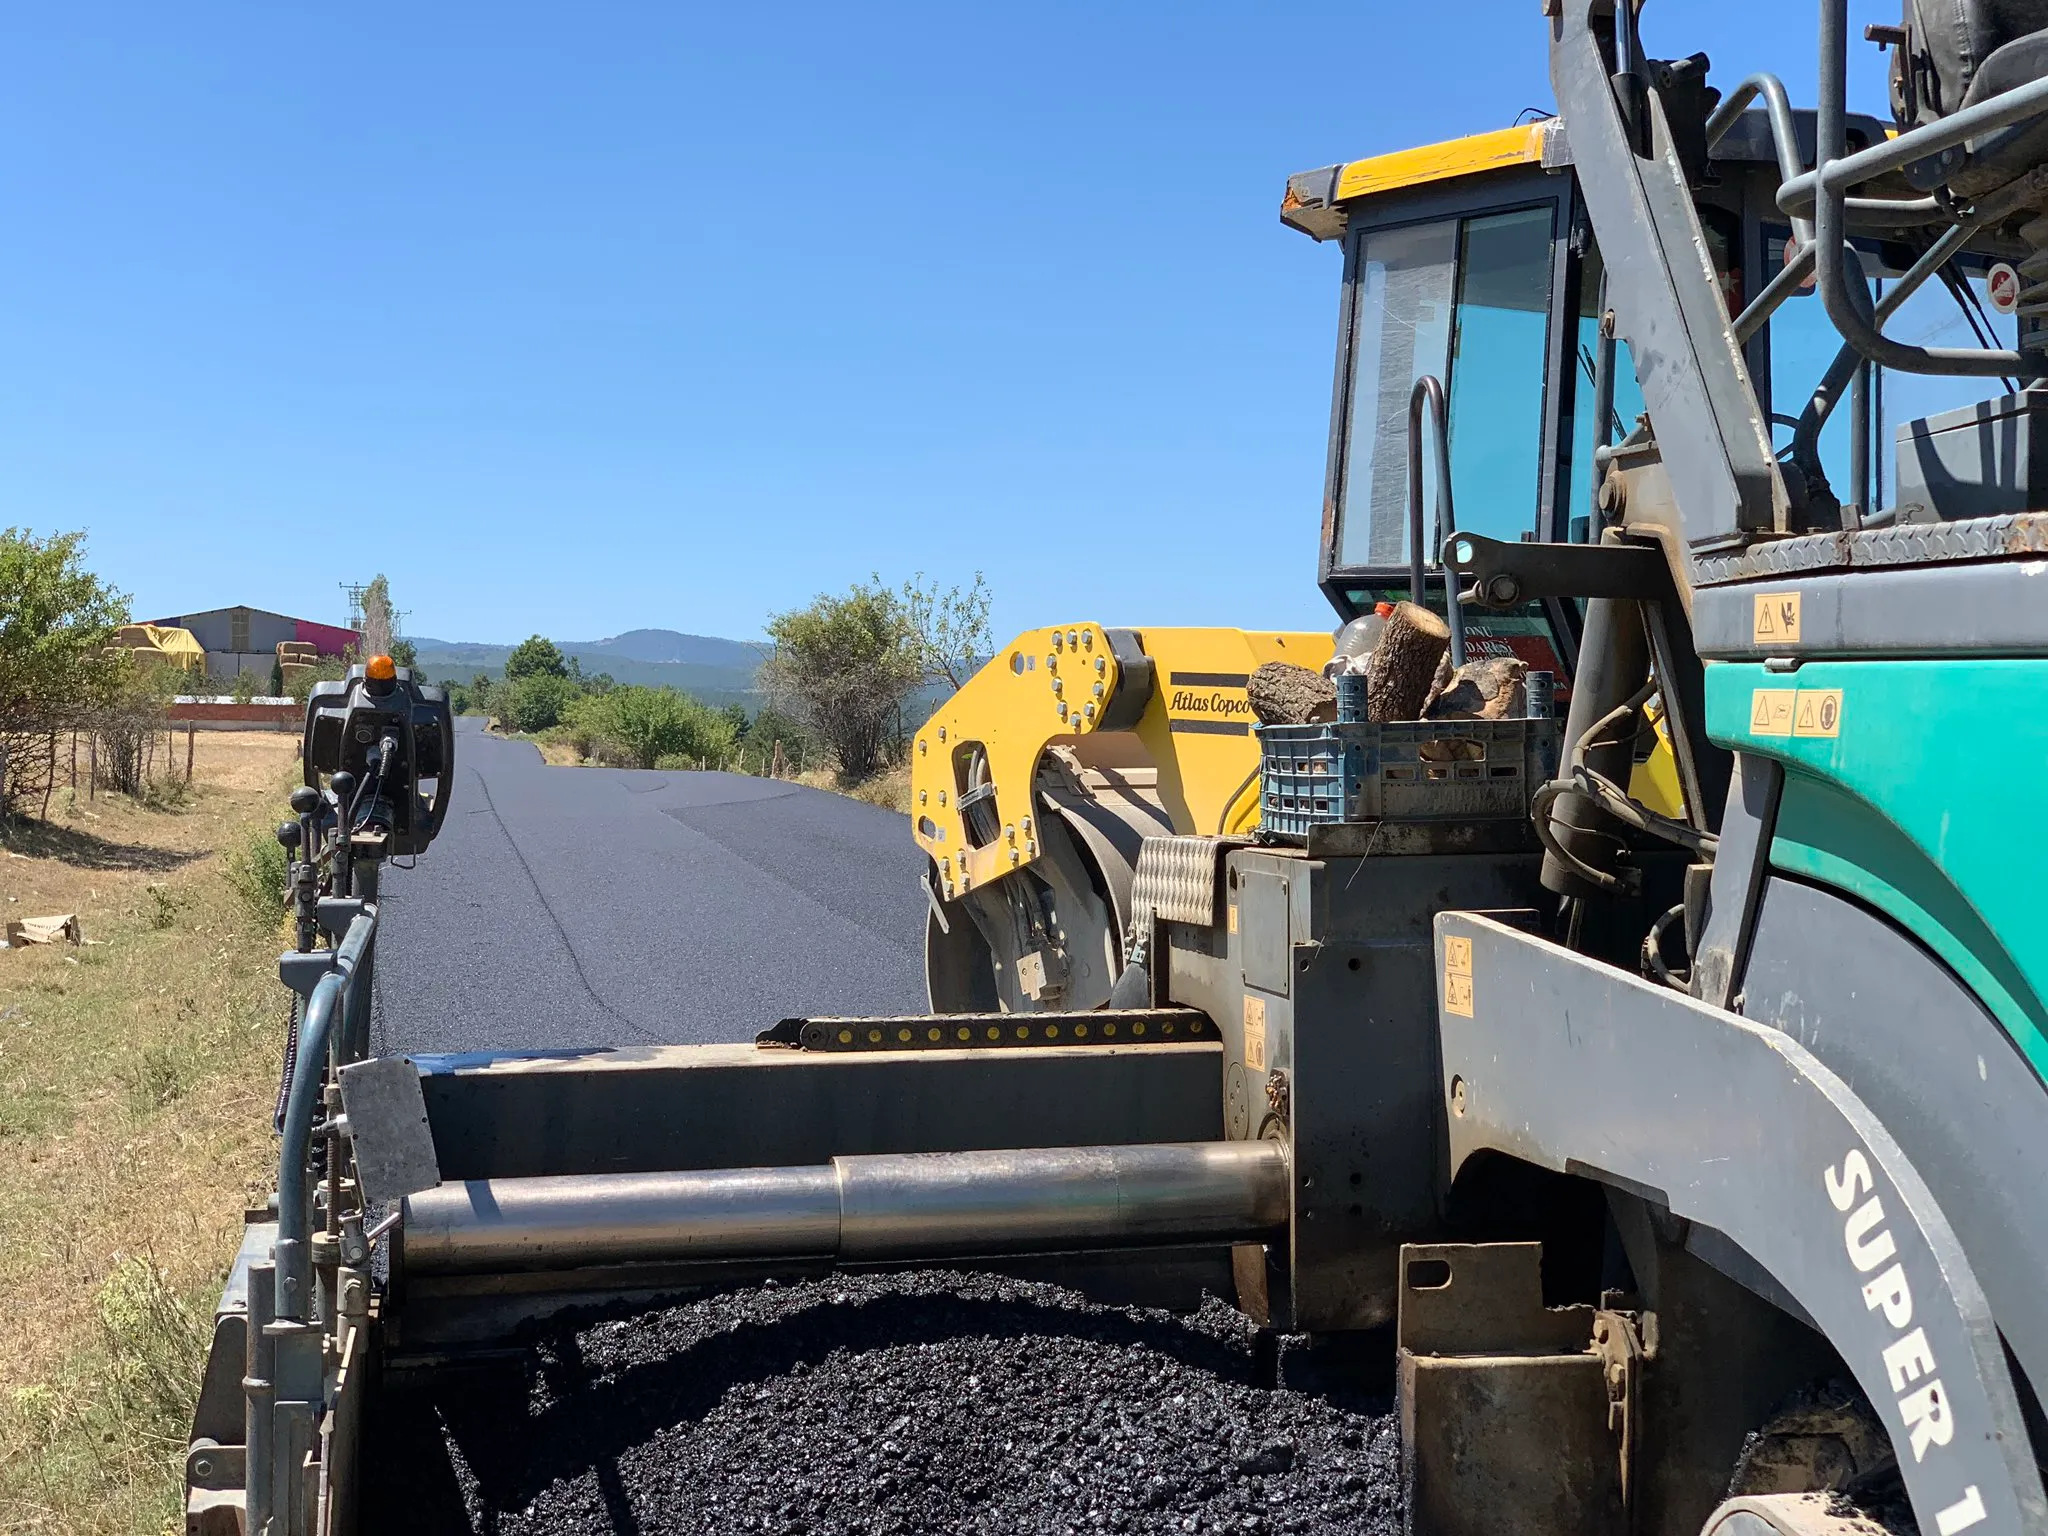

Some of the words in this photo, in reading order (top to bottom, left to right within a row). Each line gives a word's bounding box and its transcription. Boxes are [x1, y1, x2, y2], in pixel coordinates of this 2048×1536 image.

[1169, 691, 1209, 711] Atlas
[1210, 693, 1250, 717] Copco
[1823, 1149, 1954, 1464] SUPER
[1934, 1484, 1987, 1536] 1
